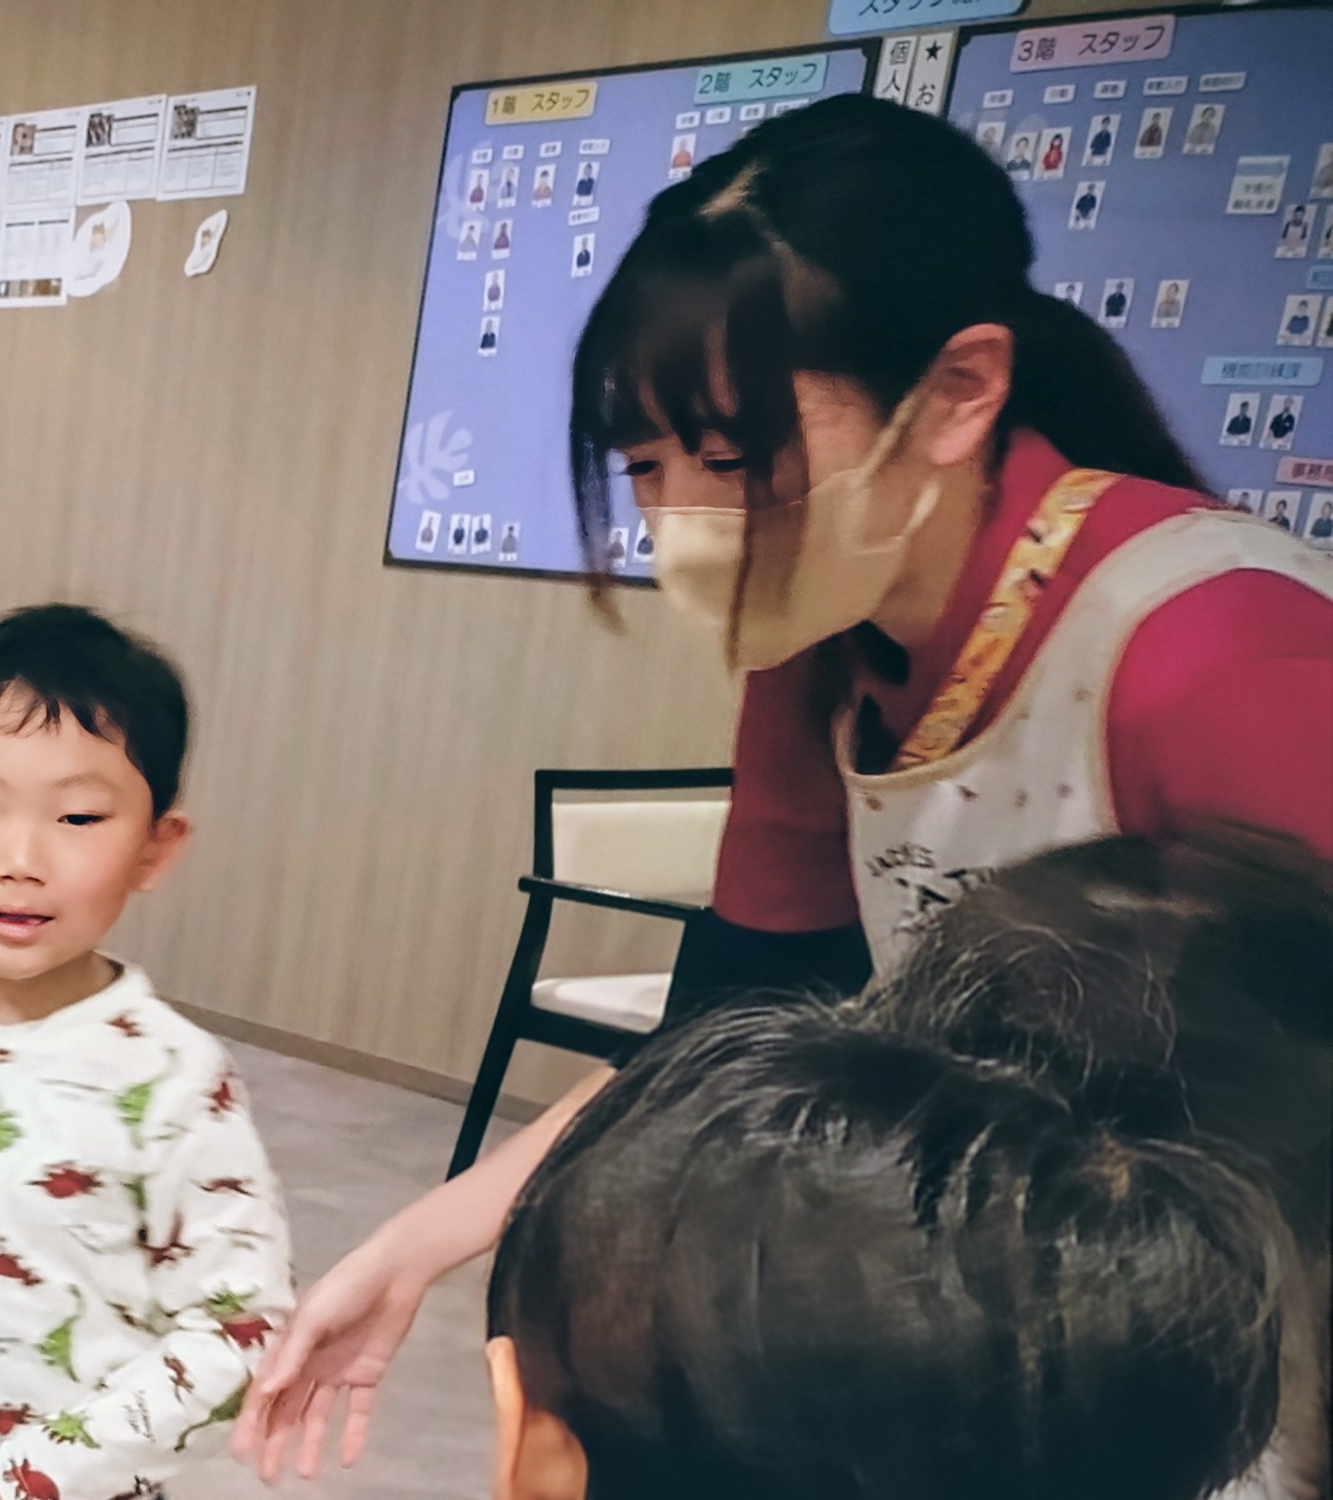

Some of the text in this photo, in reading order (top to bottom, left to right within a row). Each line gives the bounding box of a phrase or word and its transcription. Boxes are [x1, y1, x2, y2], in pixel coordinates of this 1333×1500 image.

[1016, 26, 1166, 63] 3階 スタッフ
[699, 63, 818, 94] 2階 スタッフ
[882, 41, 912, 100] 個人
[492, 89, 590, 116] 1階 スタッフ
